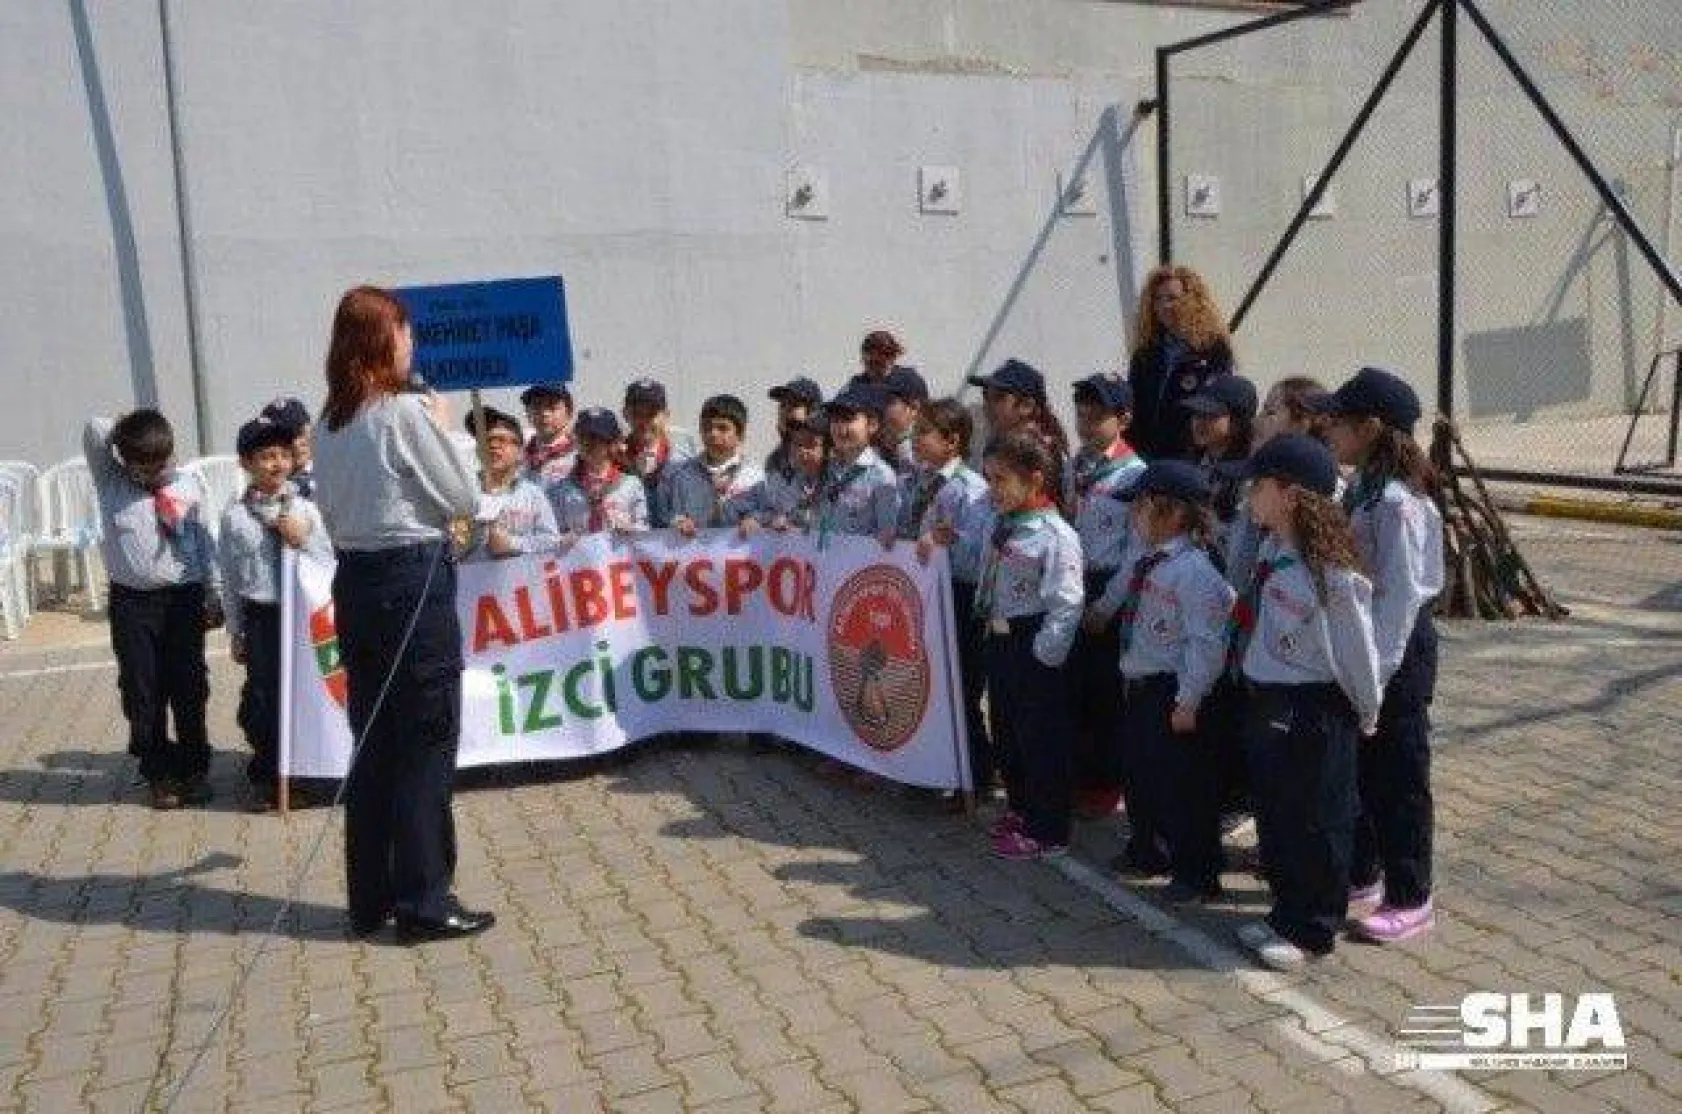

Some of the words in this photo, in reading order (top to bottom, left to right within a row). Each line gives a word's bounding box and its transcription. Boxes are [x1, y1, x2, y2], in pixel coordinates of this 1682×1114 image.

[474, 556, 817, 653] ALİBEYSPOR
[494, 640, 617, 734] İZCİ
[631, 644, 814, 713] GRUBU
